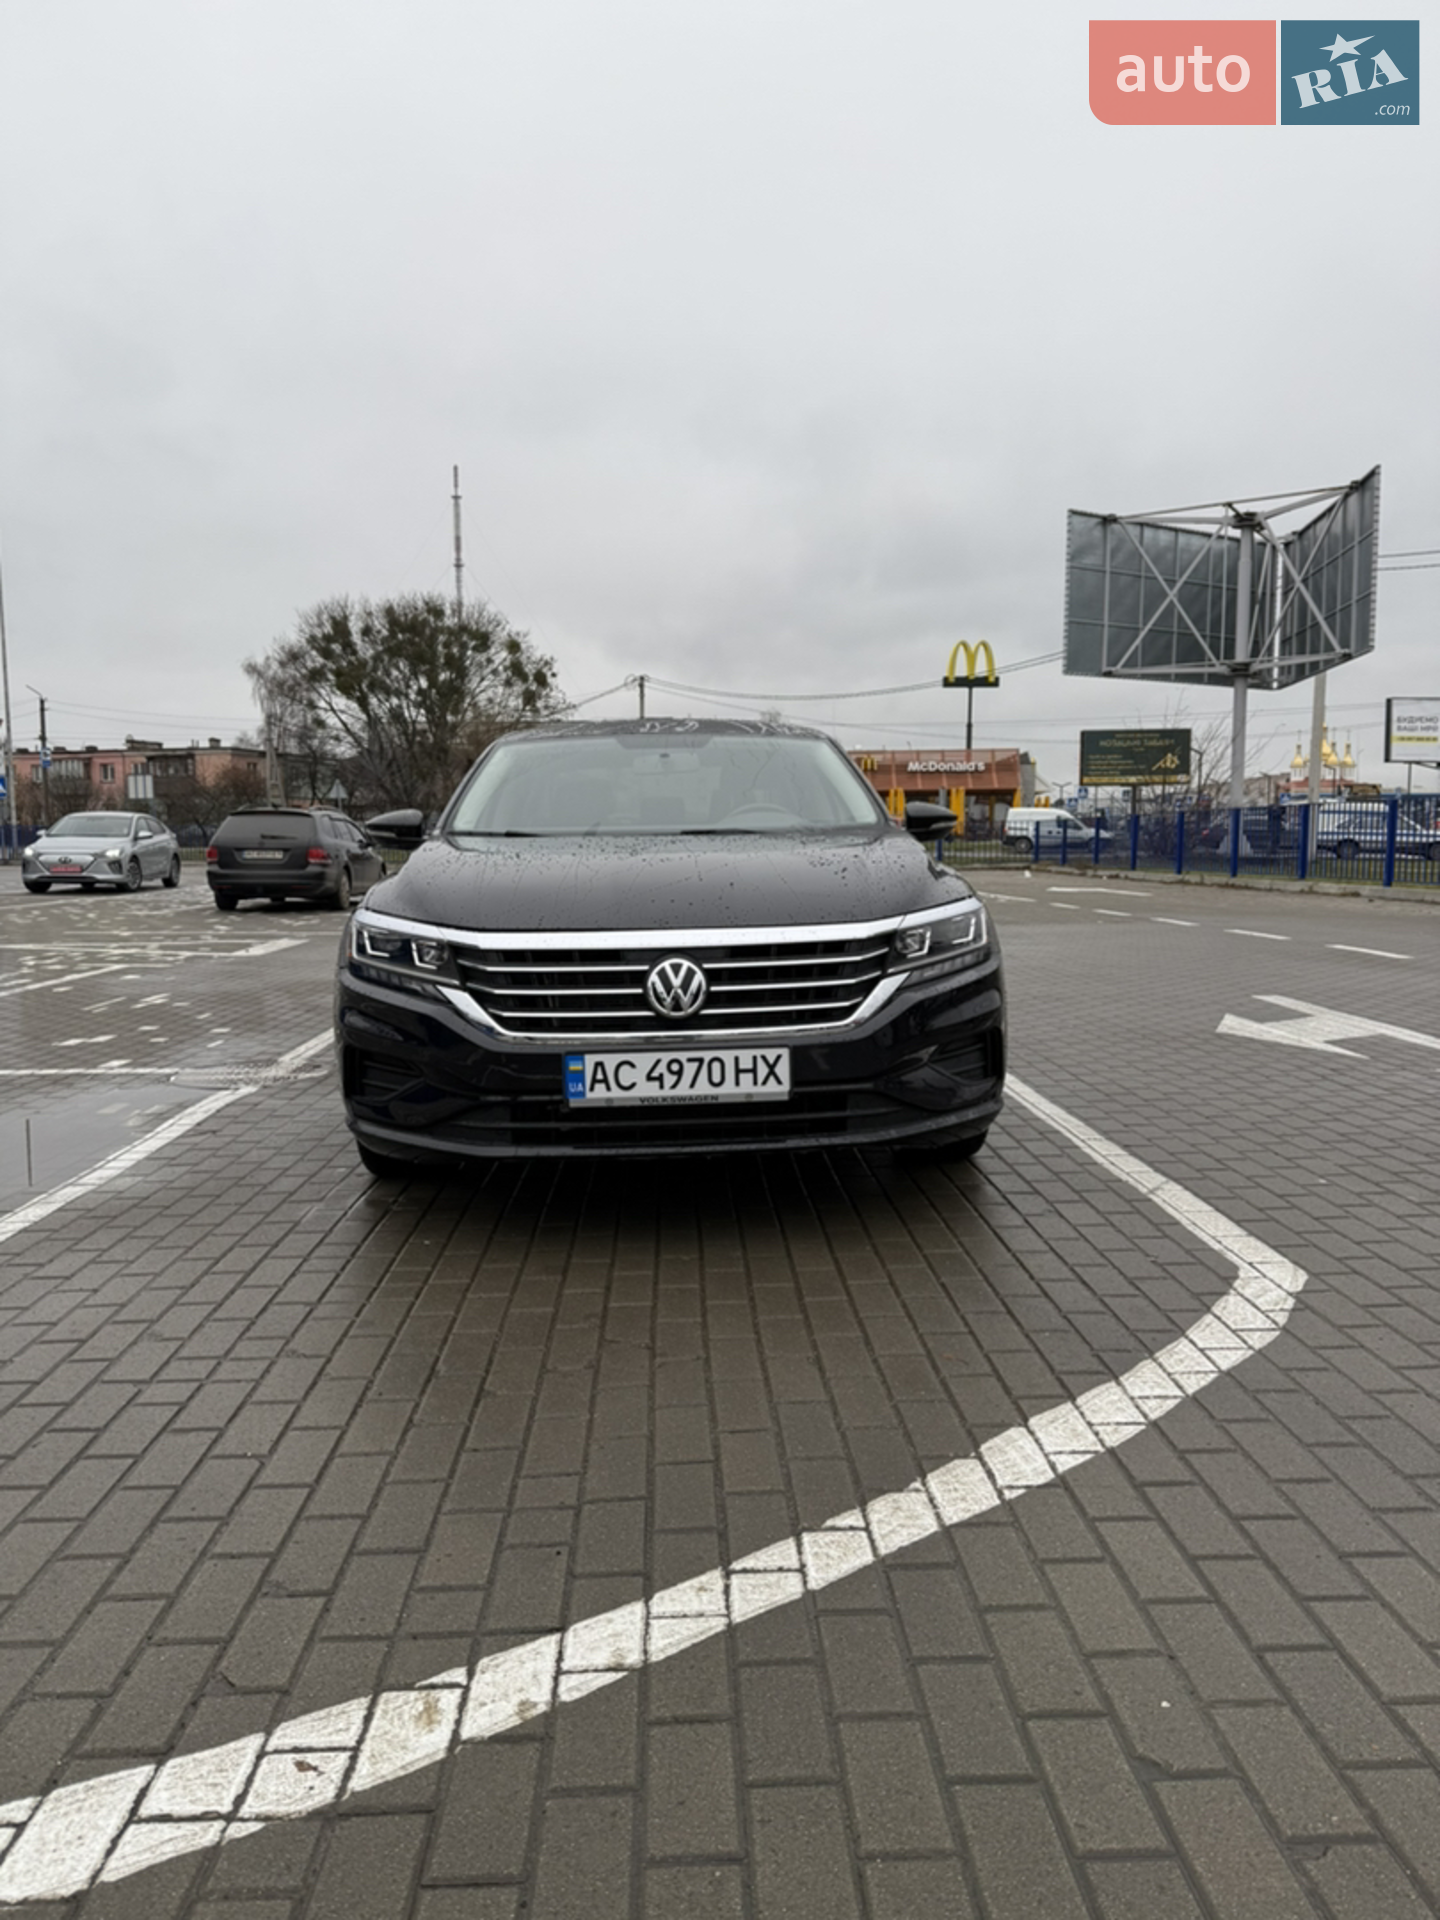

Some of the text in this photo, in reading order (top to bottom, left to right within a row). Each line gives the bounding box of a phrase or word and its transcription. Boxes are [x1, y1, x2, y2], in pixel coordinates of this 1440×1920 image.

[907, 760, 986, 773] McDonald's
[588, 1053, 784, 1093] AC 4970 HX
[568, 1082, 584, 1093] UA
[639, 1094, 719, 1105] VOLKSWAGEN
